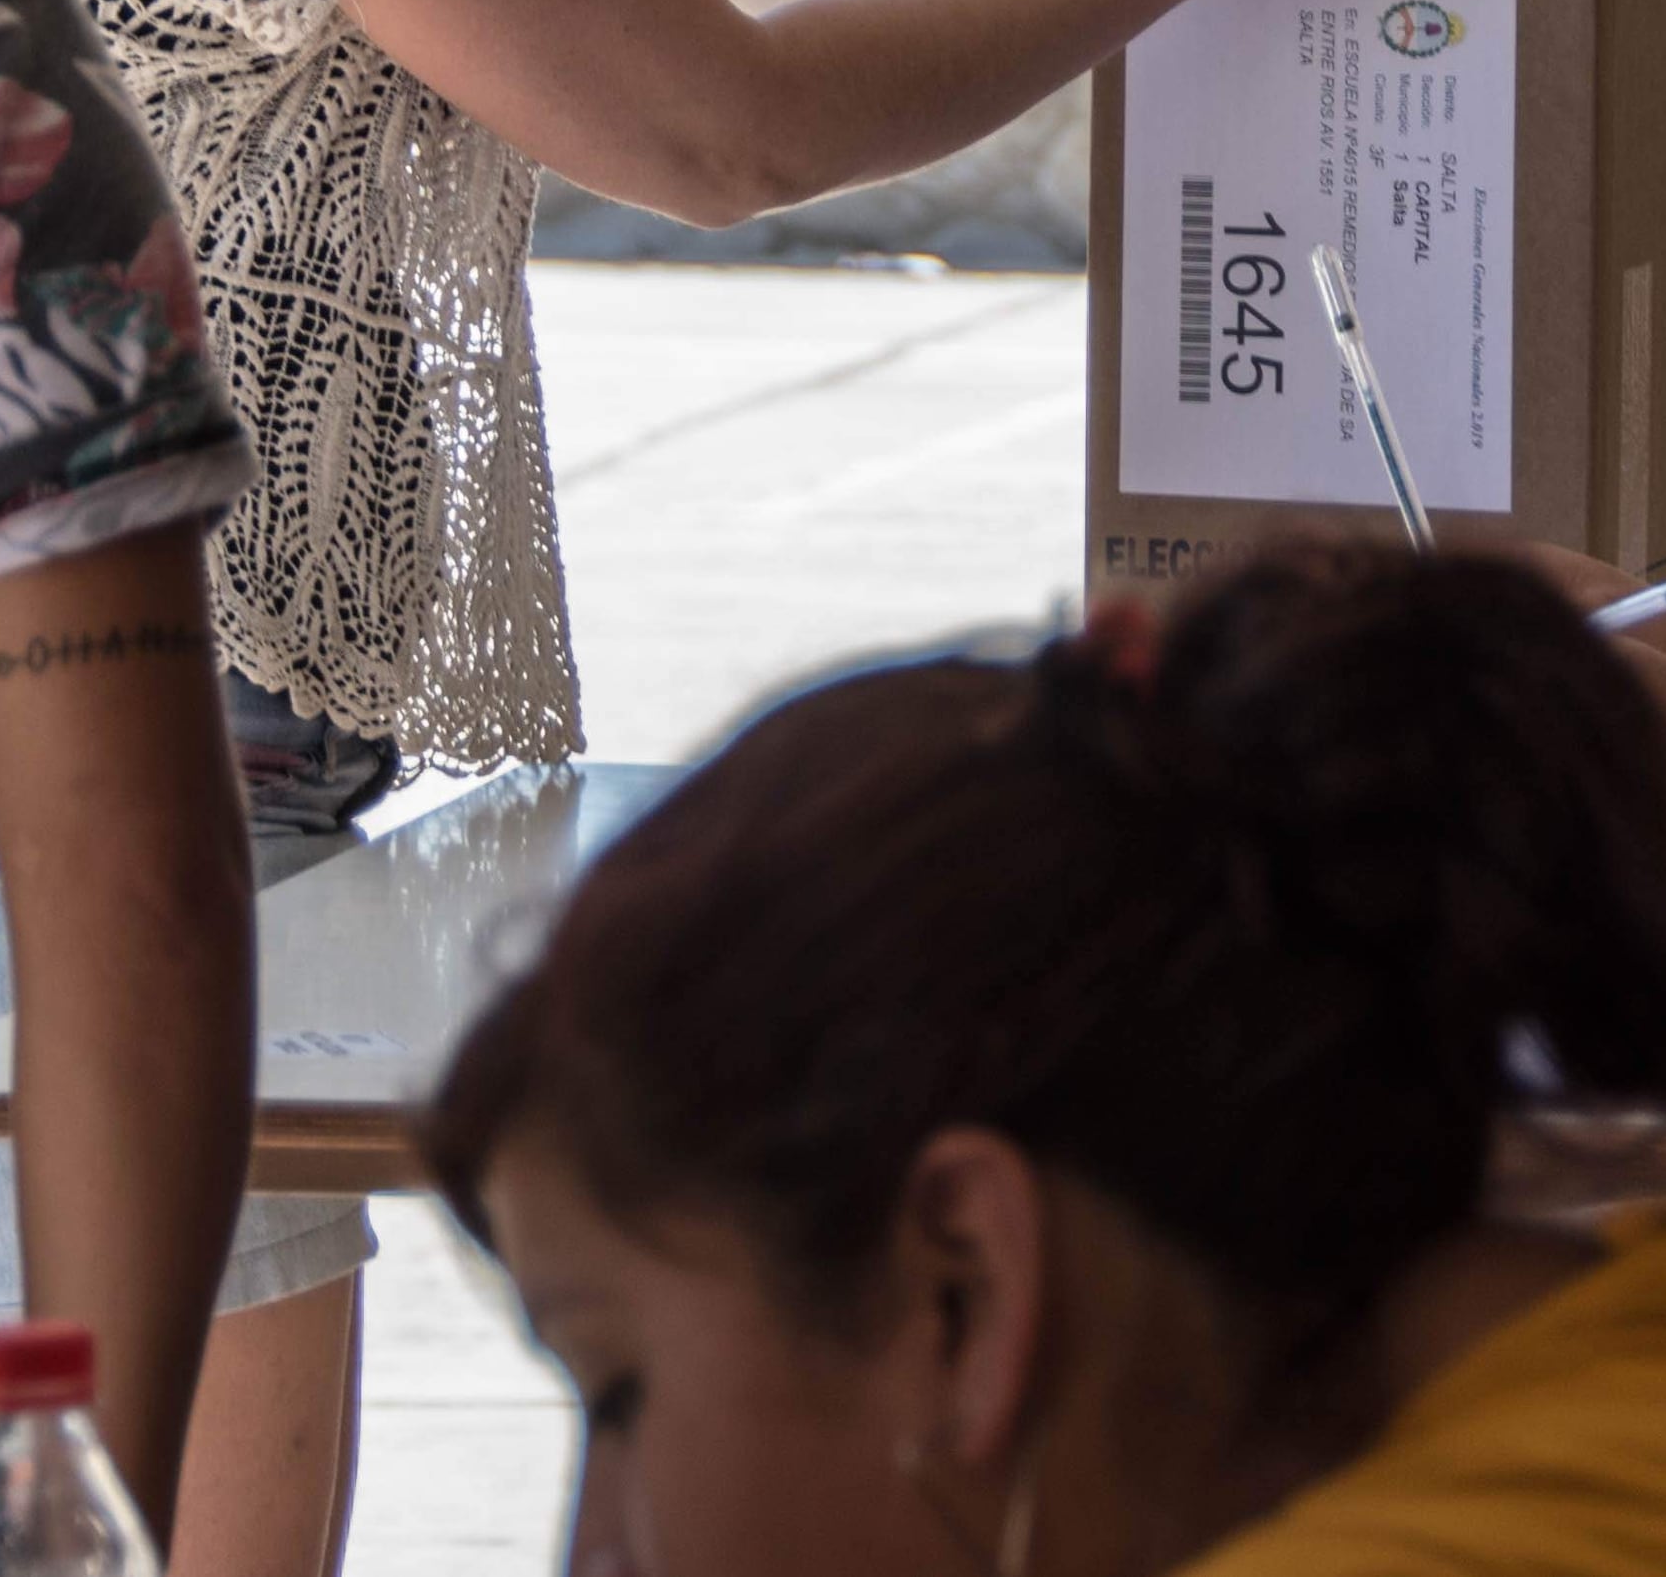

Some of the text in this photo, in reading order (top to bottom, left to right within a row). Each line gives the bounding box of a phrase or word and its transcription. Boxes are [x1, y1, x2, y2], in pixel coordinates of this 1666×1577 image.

[1298, 8, 1315, 66] SALTA
[1320, 8, 1336, 72] ENTRE
[1319, 74, 1336, 120] RIOS
[1343, 37, 1361, 122] ESCUELA
[1368, 143, 1386, 170] 3F
[1440, 151, 1457, 215] SALTA
[1393, 179, 1409, 227] Salta
[1413, 180, 1431, 266] CAPITAL
[1220, 211, 1287, 395] 1645
[1471, 261, 1487, 330] Generales
[1470, 331, 1486, 406] Nacionales
[1339, 387, 1355, 416] DE
